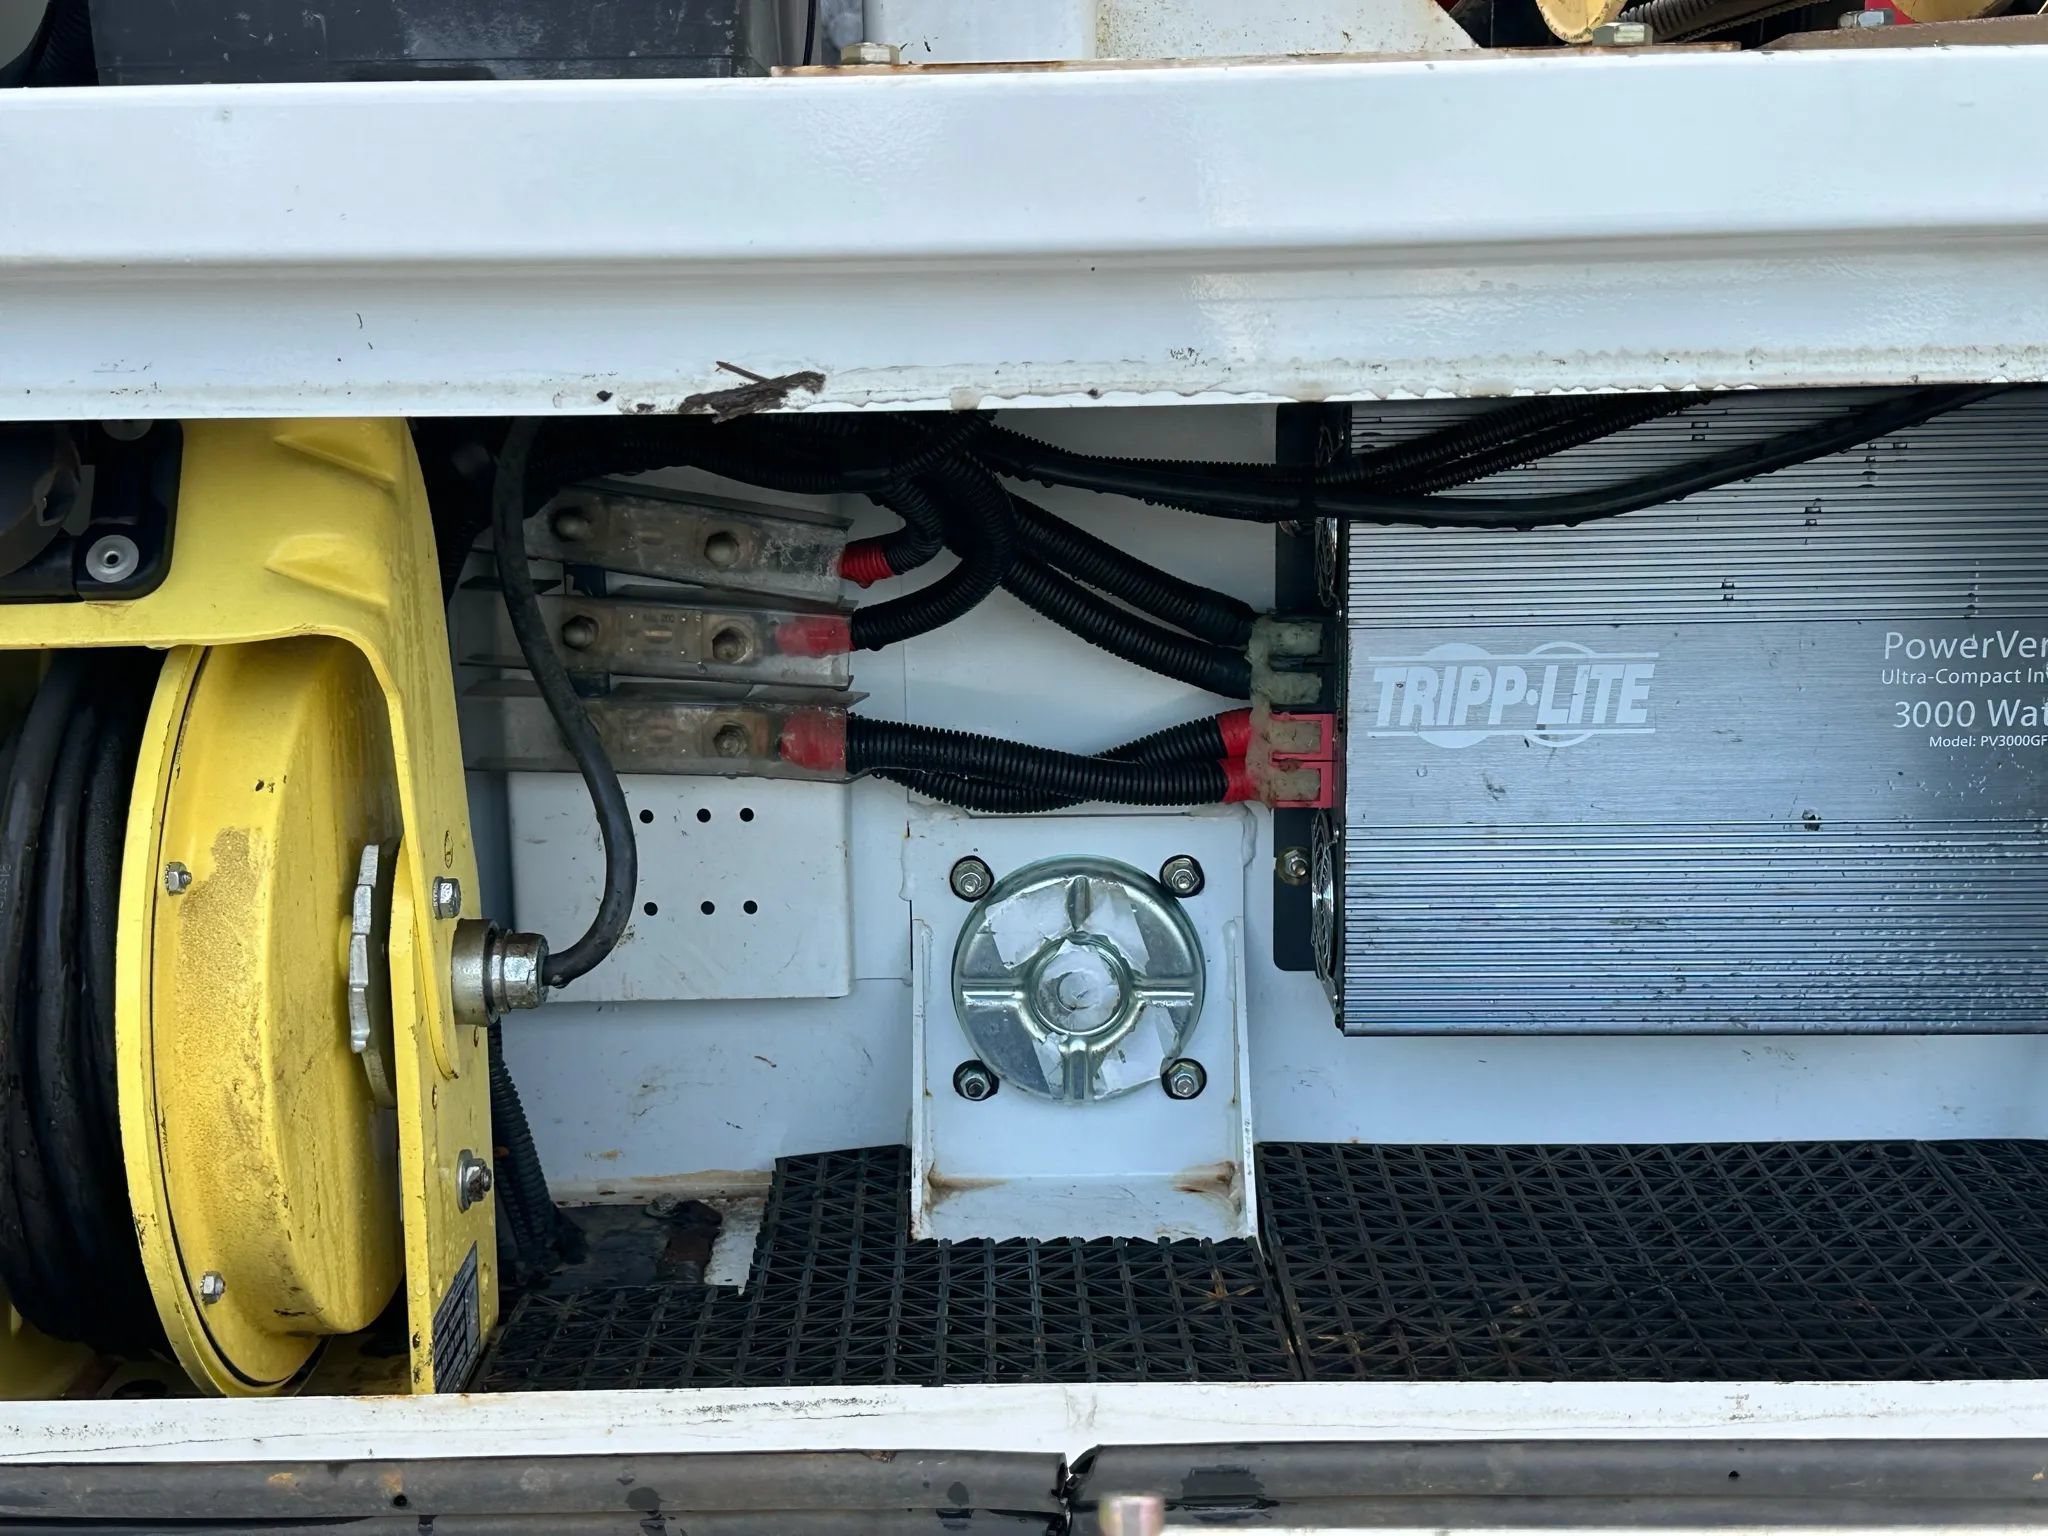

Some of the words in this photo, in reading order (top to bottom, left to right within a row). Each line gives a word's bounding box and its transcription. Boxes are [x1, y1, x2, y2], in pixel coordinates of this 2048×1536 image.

[1881, 668, 2022, 688] Ultra-Compact
[1893, 700, 1976, 728] 3000
[1929, 735, 1977, 748] Model:
